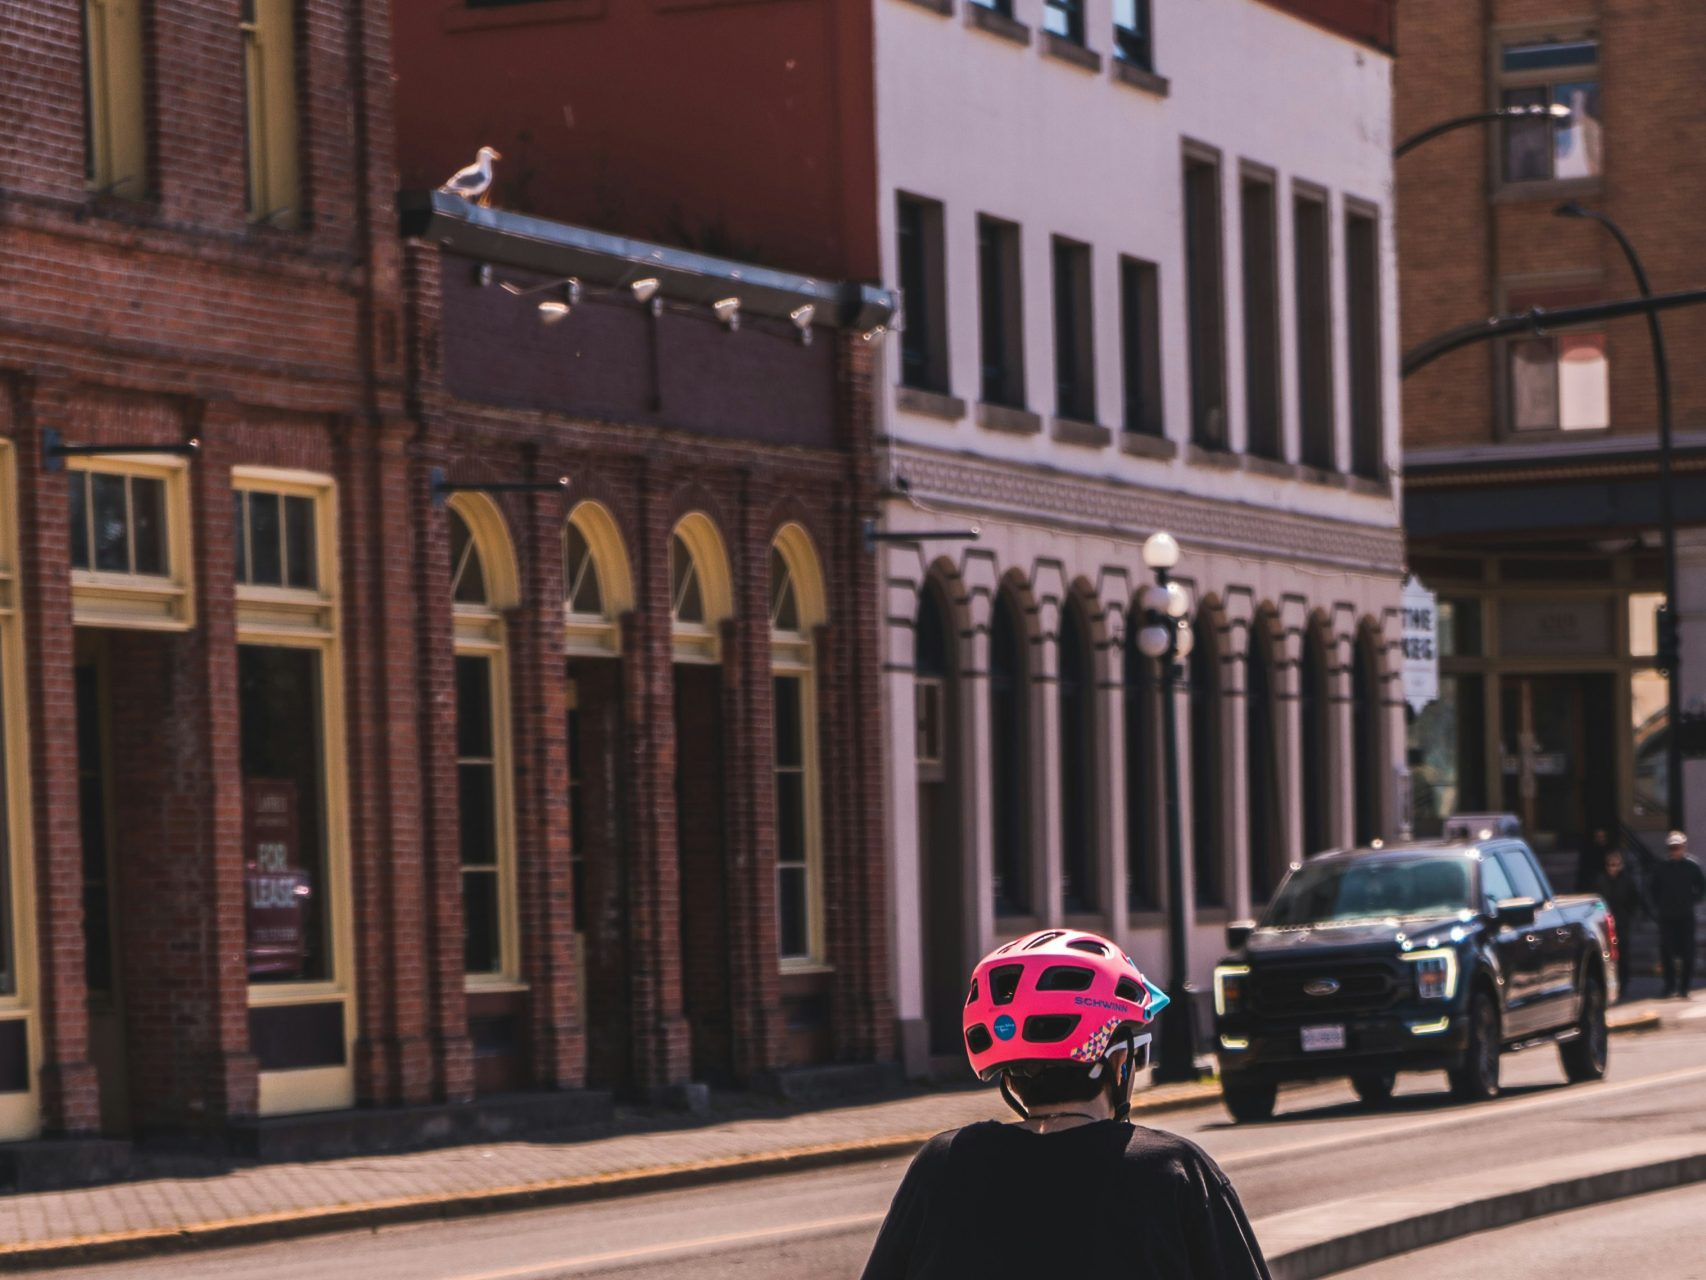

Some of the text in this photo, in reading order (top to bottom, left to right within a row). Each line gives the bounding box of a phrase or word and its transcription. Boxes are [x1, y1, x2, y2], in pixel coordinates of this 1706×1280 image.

[1402, 608, 1431, 631] THE
[1401, 637, 1433, 660] KEG
[257, 842, 288, 872] FOR
[250, 879, 298, 908] LEASE
[1075, 996, 1128, 1012] SCHWINN
